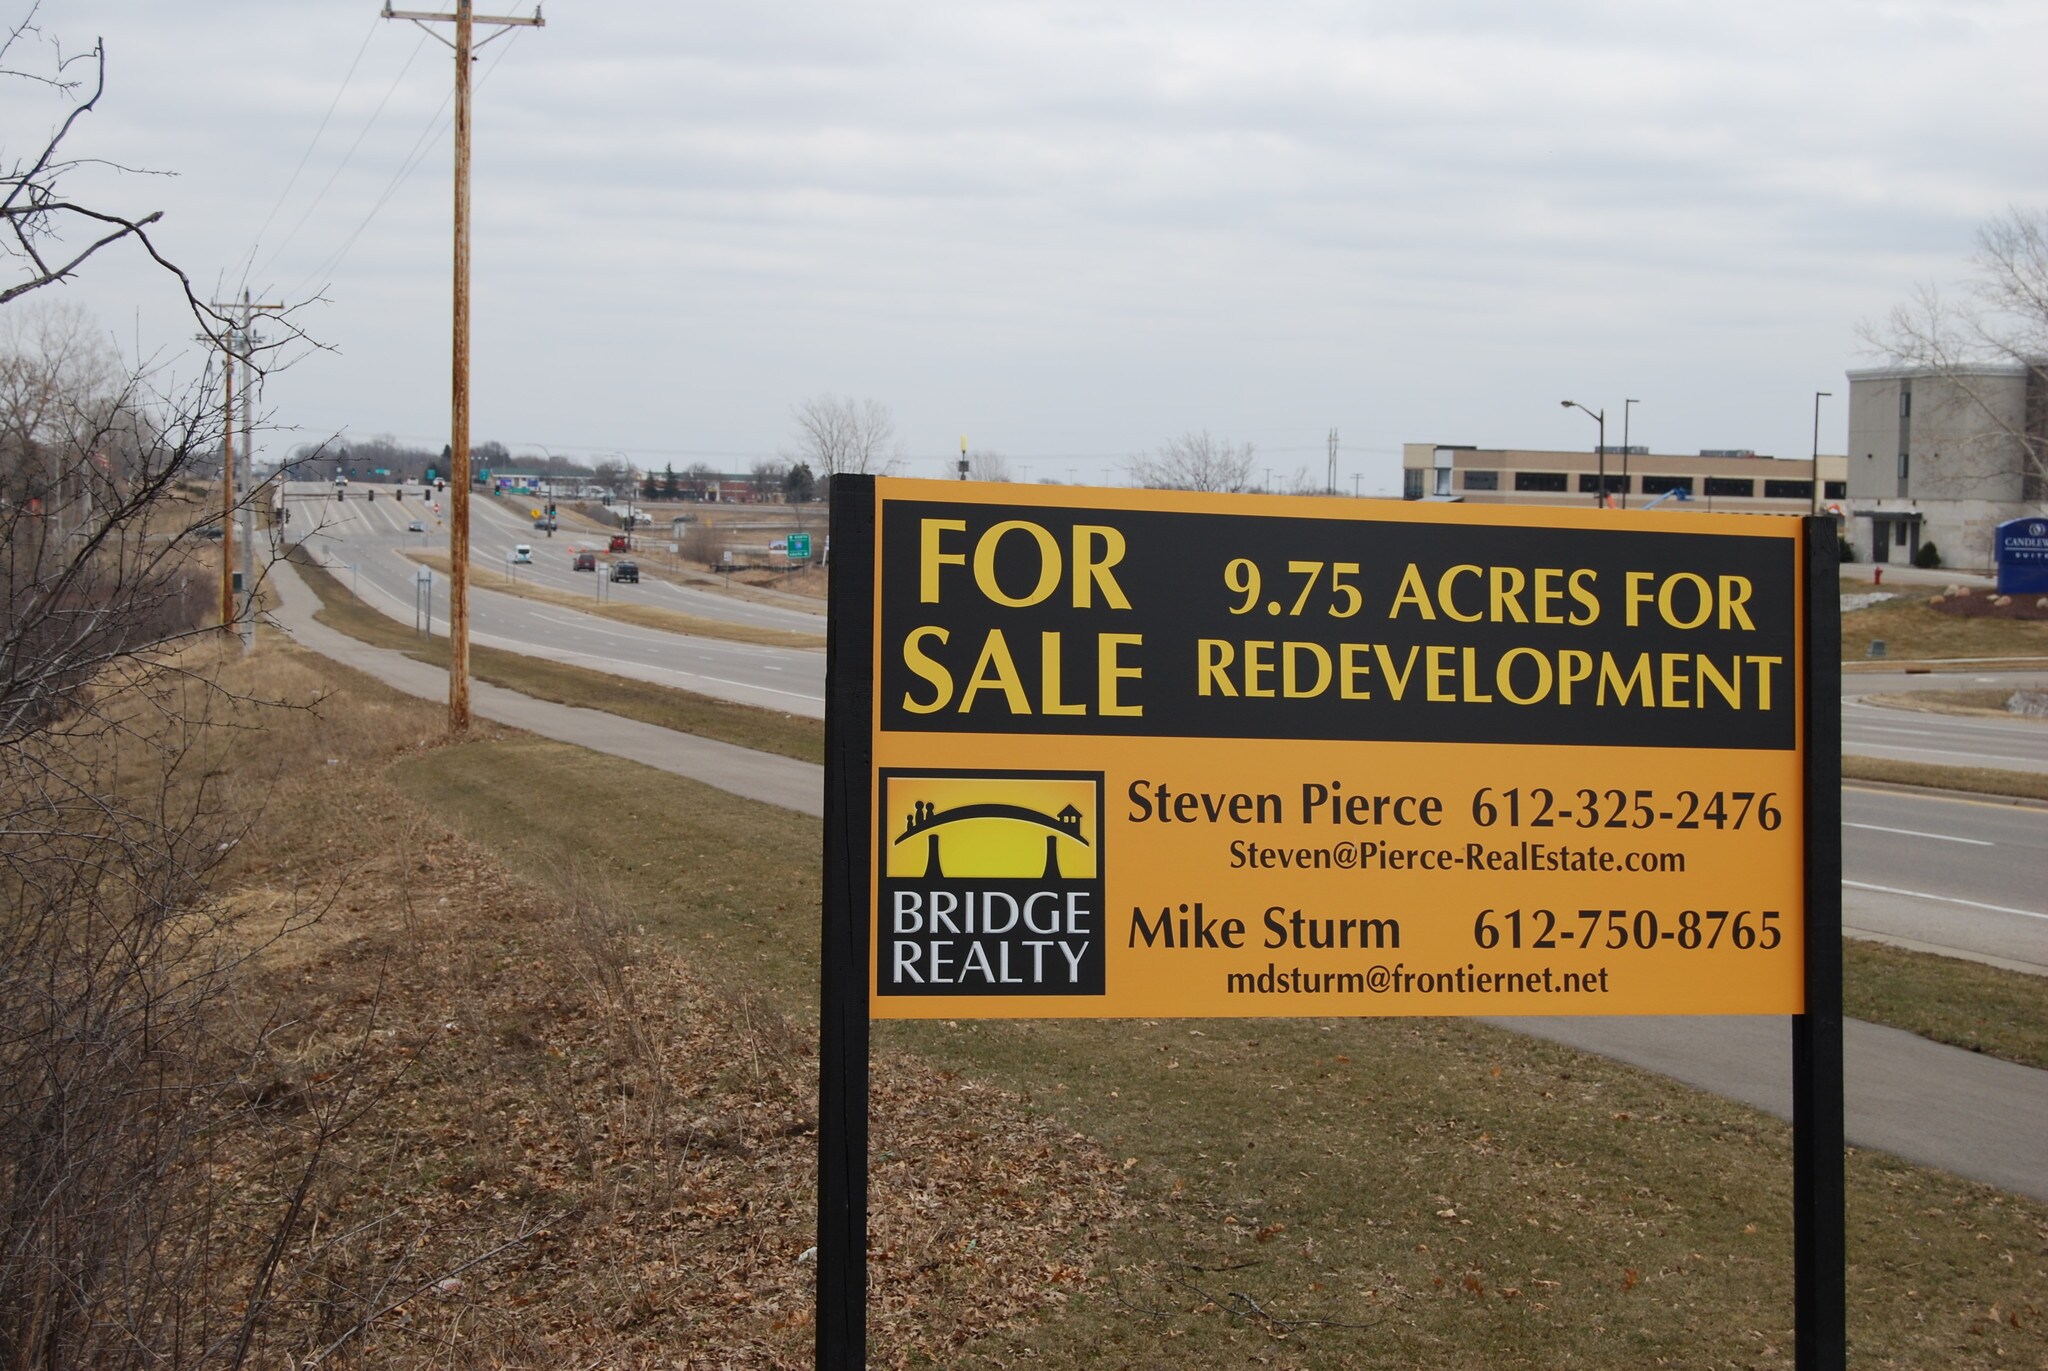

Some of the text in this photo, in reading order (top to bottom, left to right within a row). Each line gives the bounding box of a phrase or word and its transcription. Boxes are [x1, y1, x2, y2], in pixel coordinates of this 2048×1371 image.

[920, 518, 1133, 610] FOR
[1224, 558, 1756, 631] 9.75 ACRES FOR
[902, 625, 1143, 717] SALE
[1197, 638, 1783, 711] REDEVELOPMENT
[1128, 779, 1782, 831] Steven Pierce 612-325-2476
[1230, 839, 1685, 872] Steven@Pierce-RealEstate.com
[893, 890, 1090, 935] BRIDGE
[1128, 902, 1782, 950] Mike Sturm 612-750-8765
[893, 940, 1090, 984] REALTY
[1227, 962, 1609, 994] mdsturm@frontiernet.net
